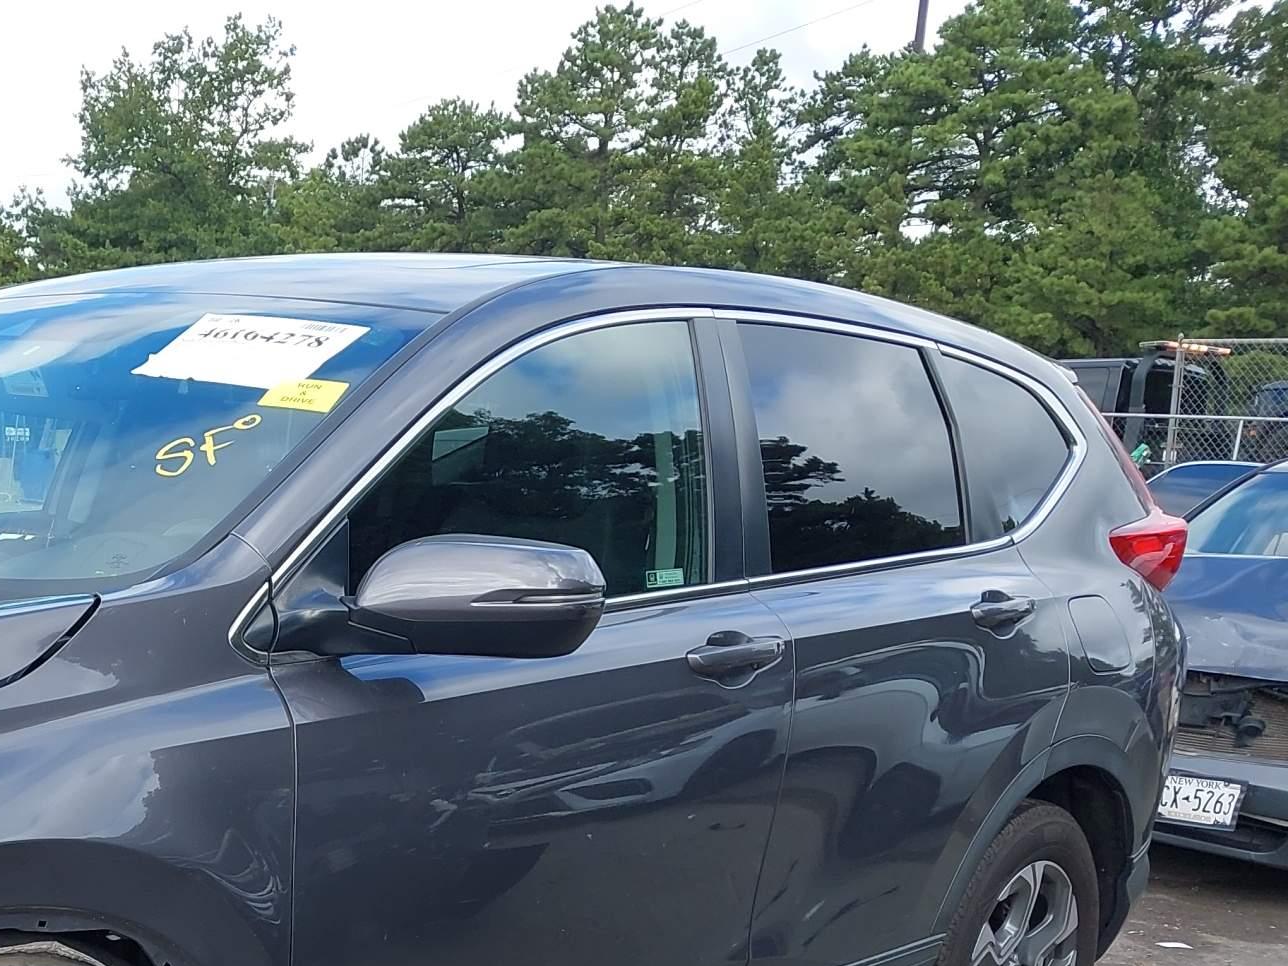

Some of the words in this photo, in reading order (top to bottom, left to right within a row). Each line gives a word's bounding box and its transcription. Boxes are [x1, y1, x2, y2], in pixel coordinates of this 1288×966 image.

[298, 382, 323, 390] RUN
[280, 396, 316, 404] DRIVE
[1170, 776, 1194, 786] NEW
[1196, 779, 1222, 790] YORK
